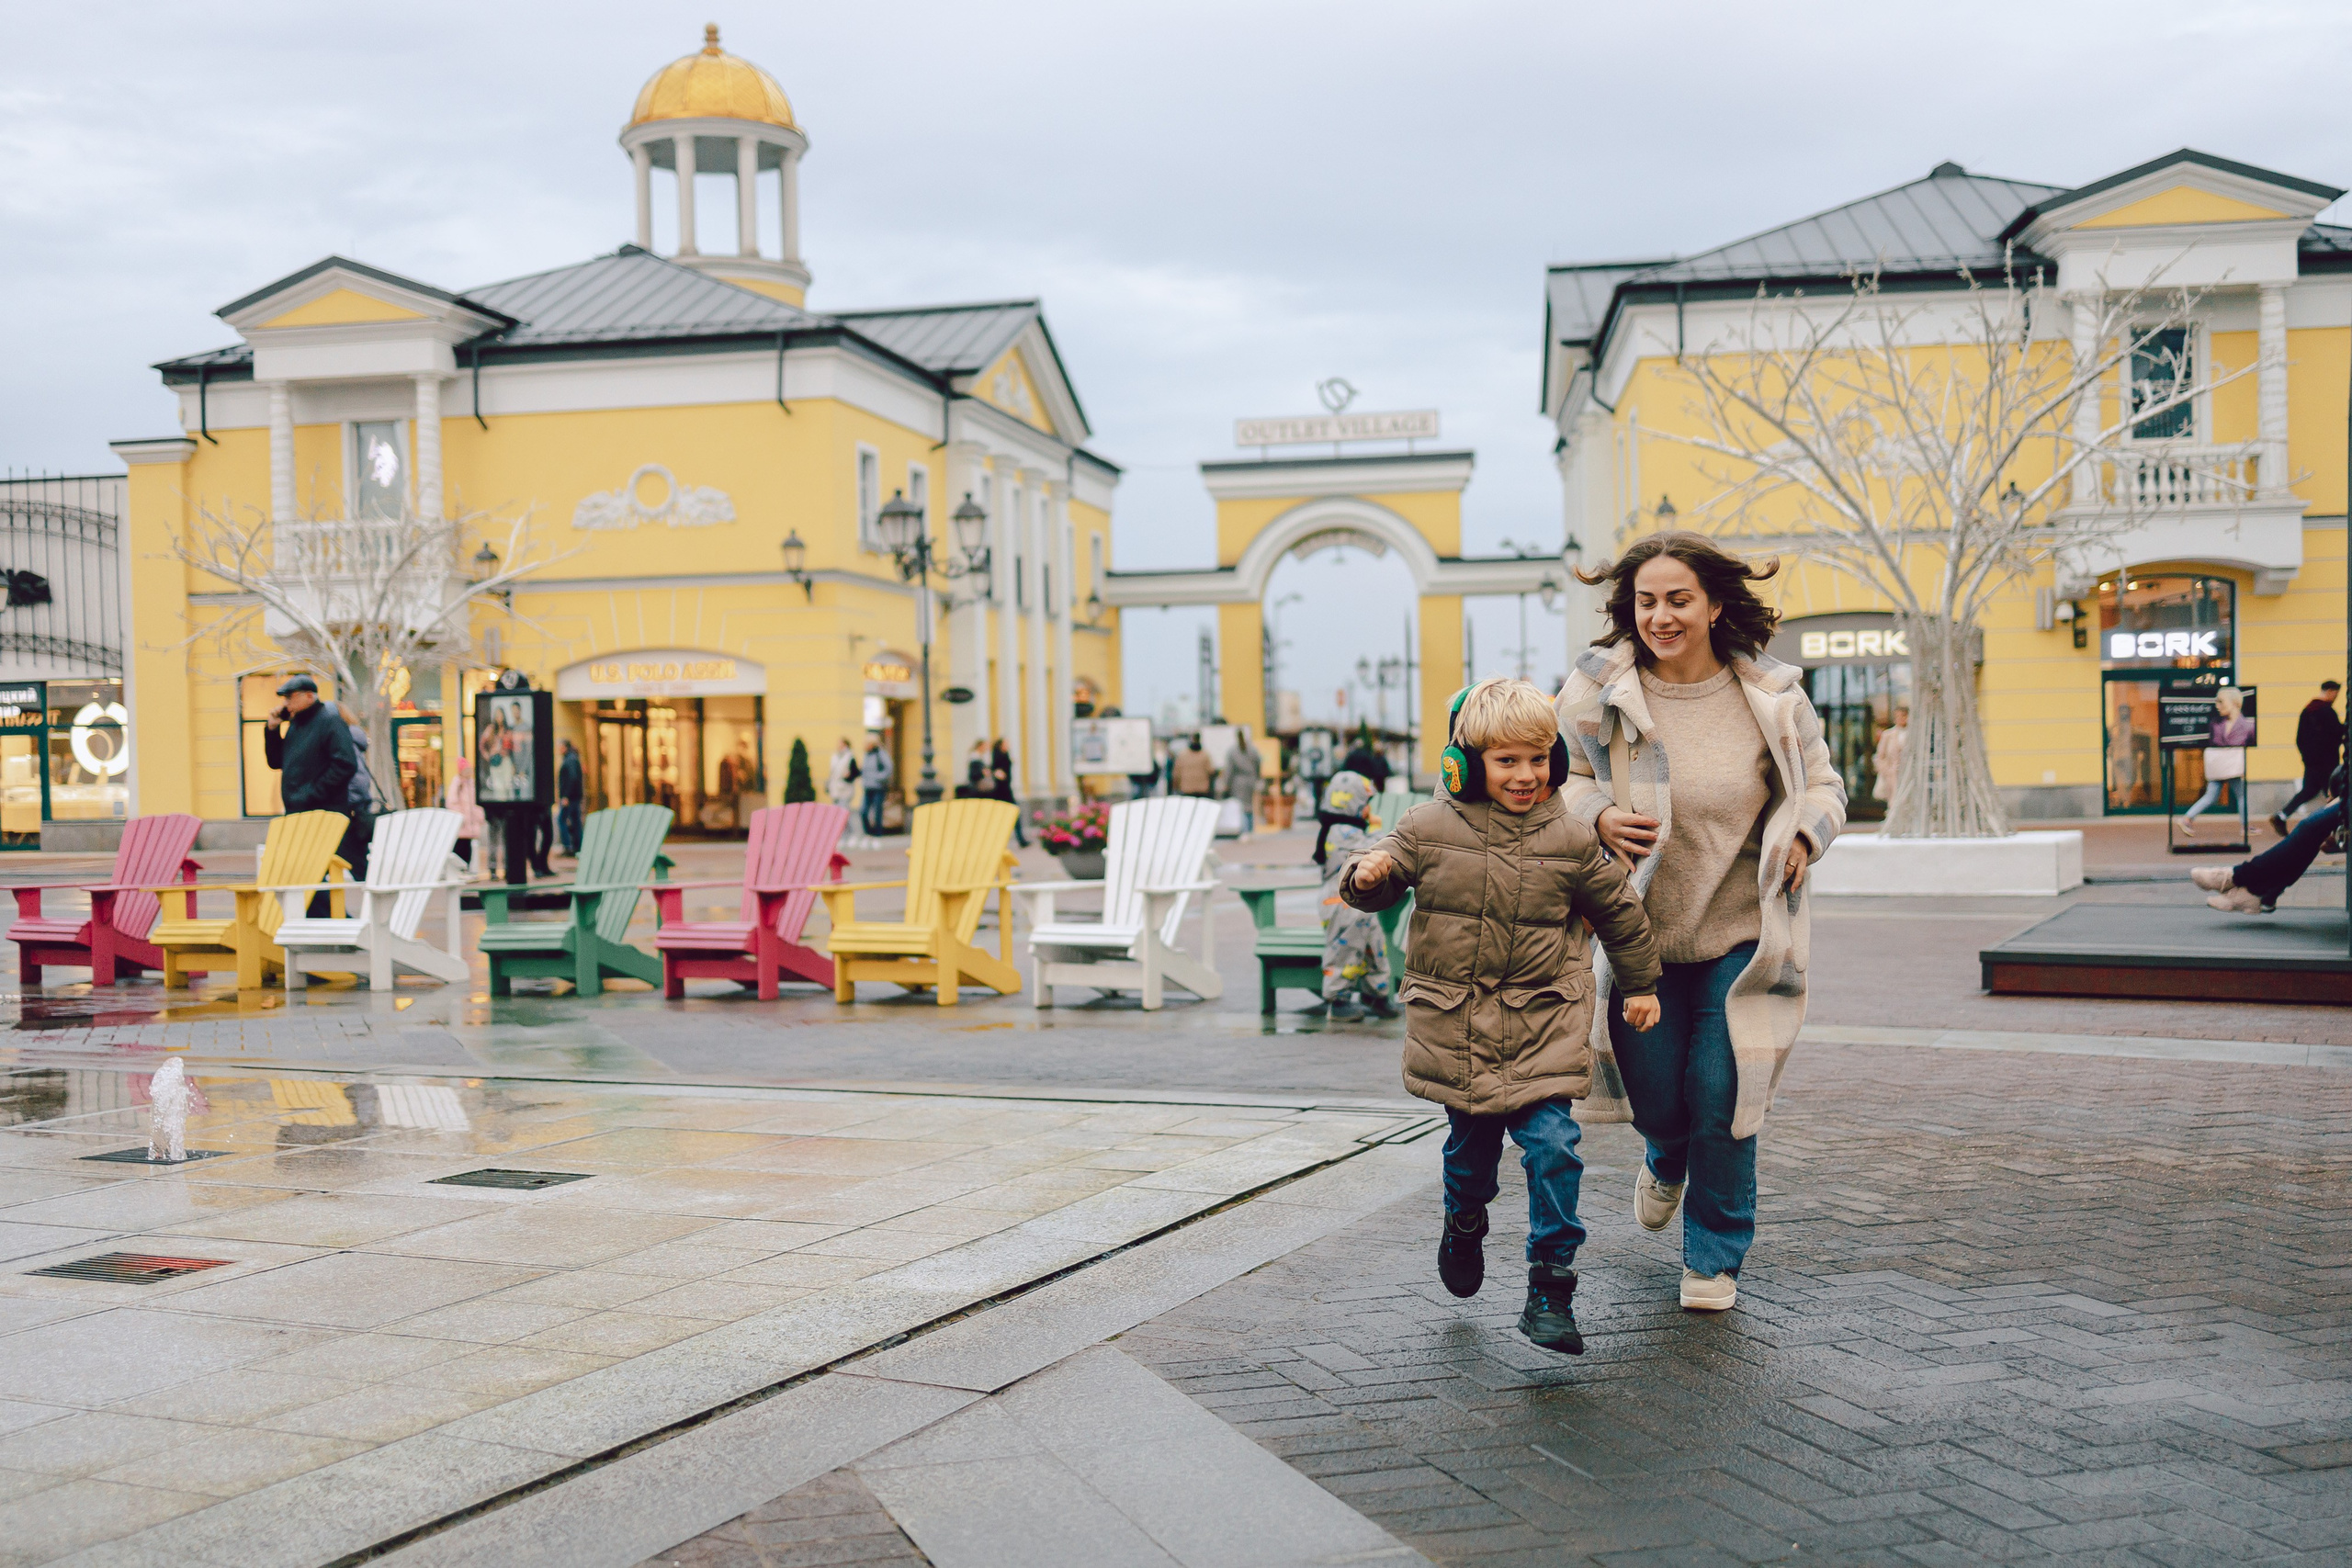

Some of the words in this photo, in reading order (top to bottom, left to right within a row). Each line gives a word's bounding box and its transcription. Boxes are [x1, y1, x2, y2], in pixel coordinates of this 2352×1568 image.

[1241, 419, 1331, 441] OUTLET
[1337, 413, 1430, 435] VILLAGE
[1801, 630, 1910, 659] BORK
[2110, 631, 2218, 658] BORK
[628, 661, 679, 683] POLO
[0, 687, 38, 704] ЦКИЙ
